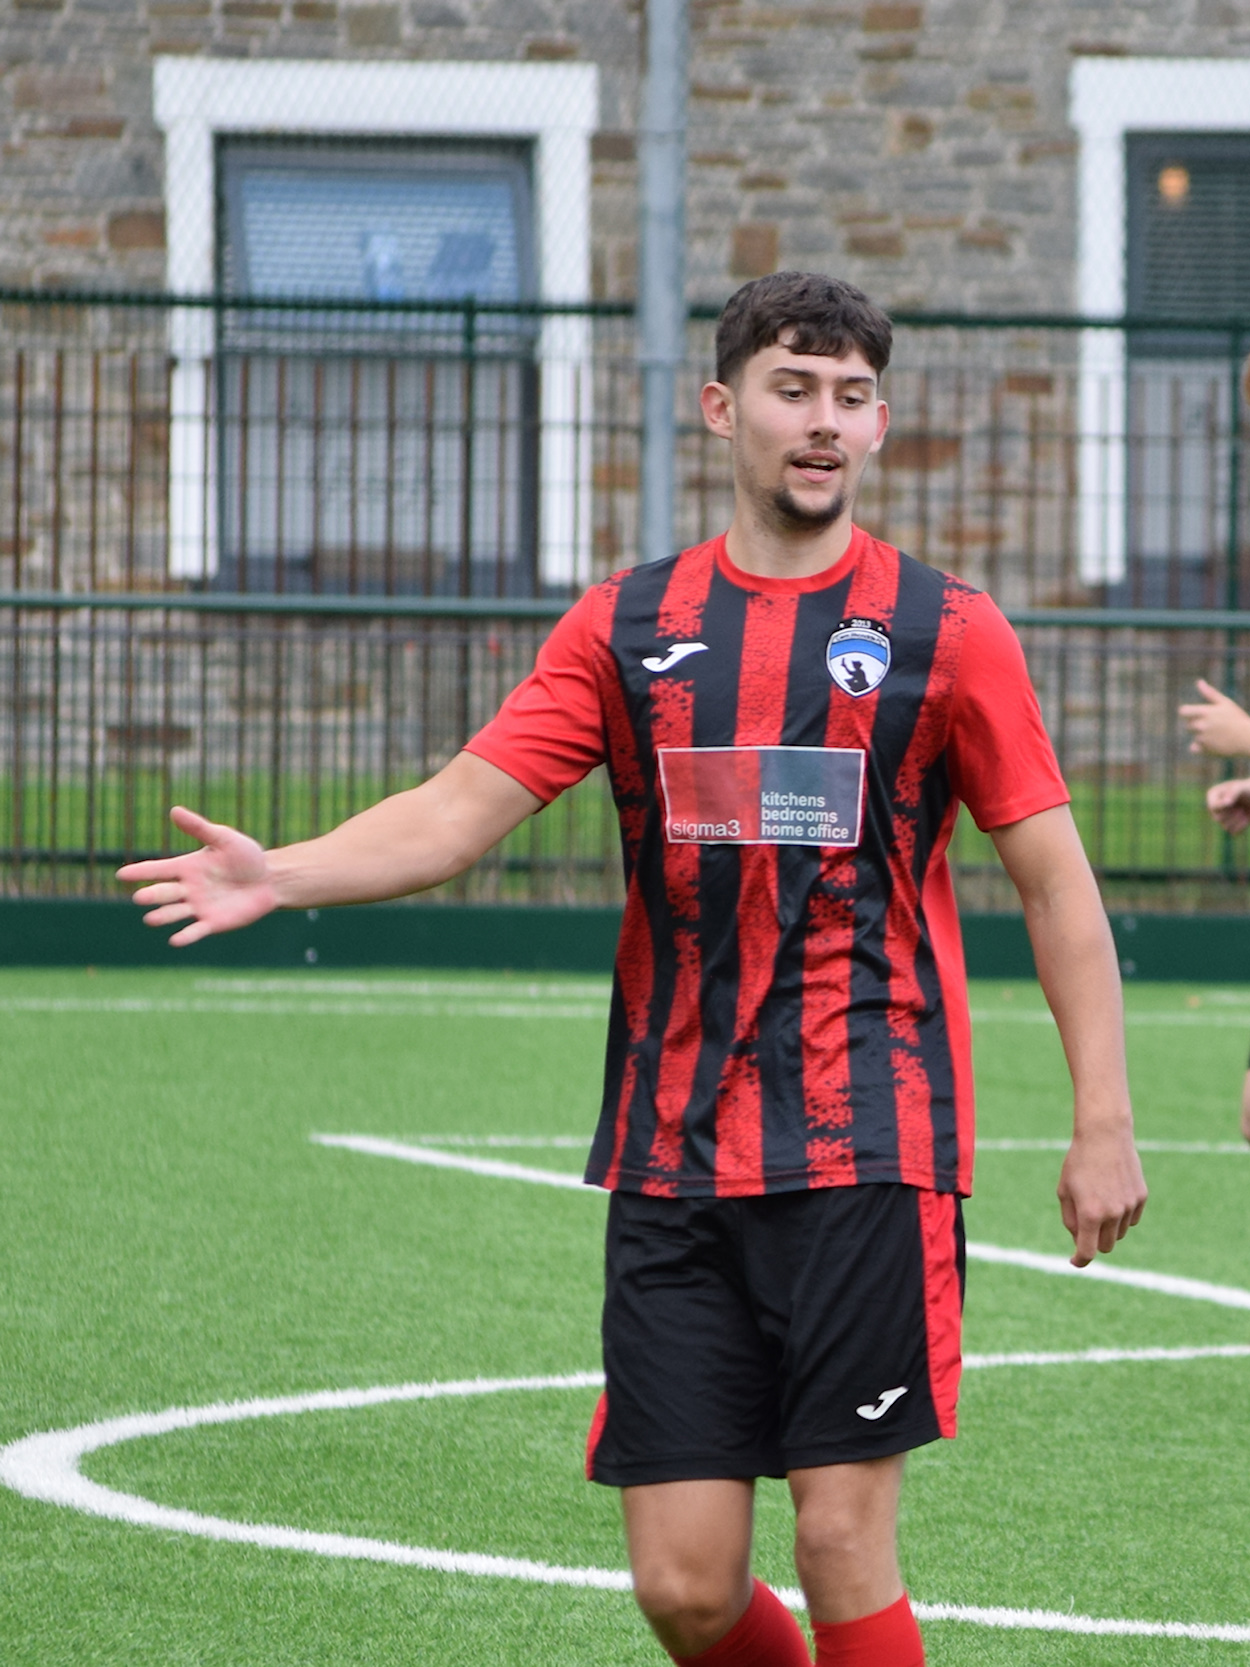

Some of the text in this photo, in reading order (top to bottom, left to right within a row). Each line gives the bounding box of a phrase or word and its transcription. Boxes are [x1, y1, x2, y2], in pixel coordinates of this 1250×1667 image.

[761, 792, 826, 808] kitchens
[761, 807, 838, 824] bedrooms
[672, 819, 741, 839] sigma3
[761, 822, 849, 839] home office
